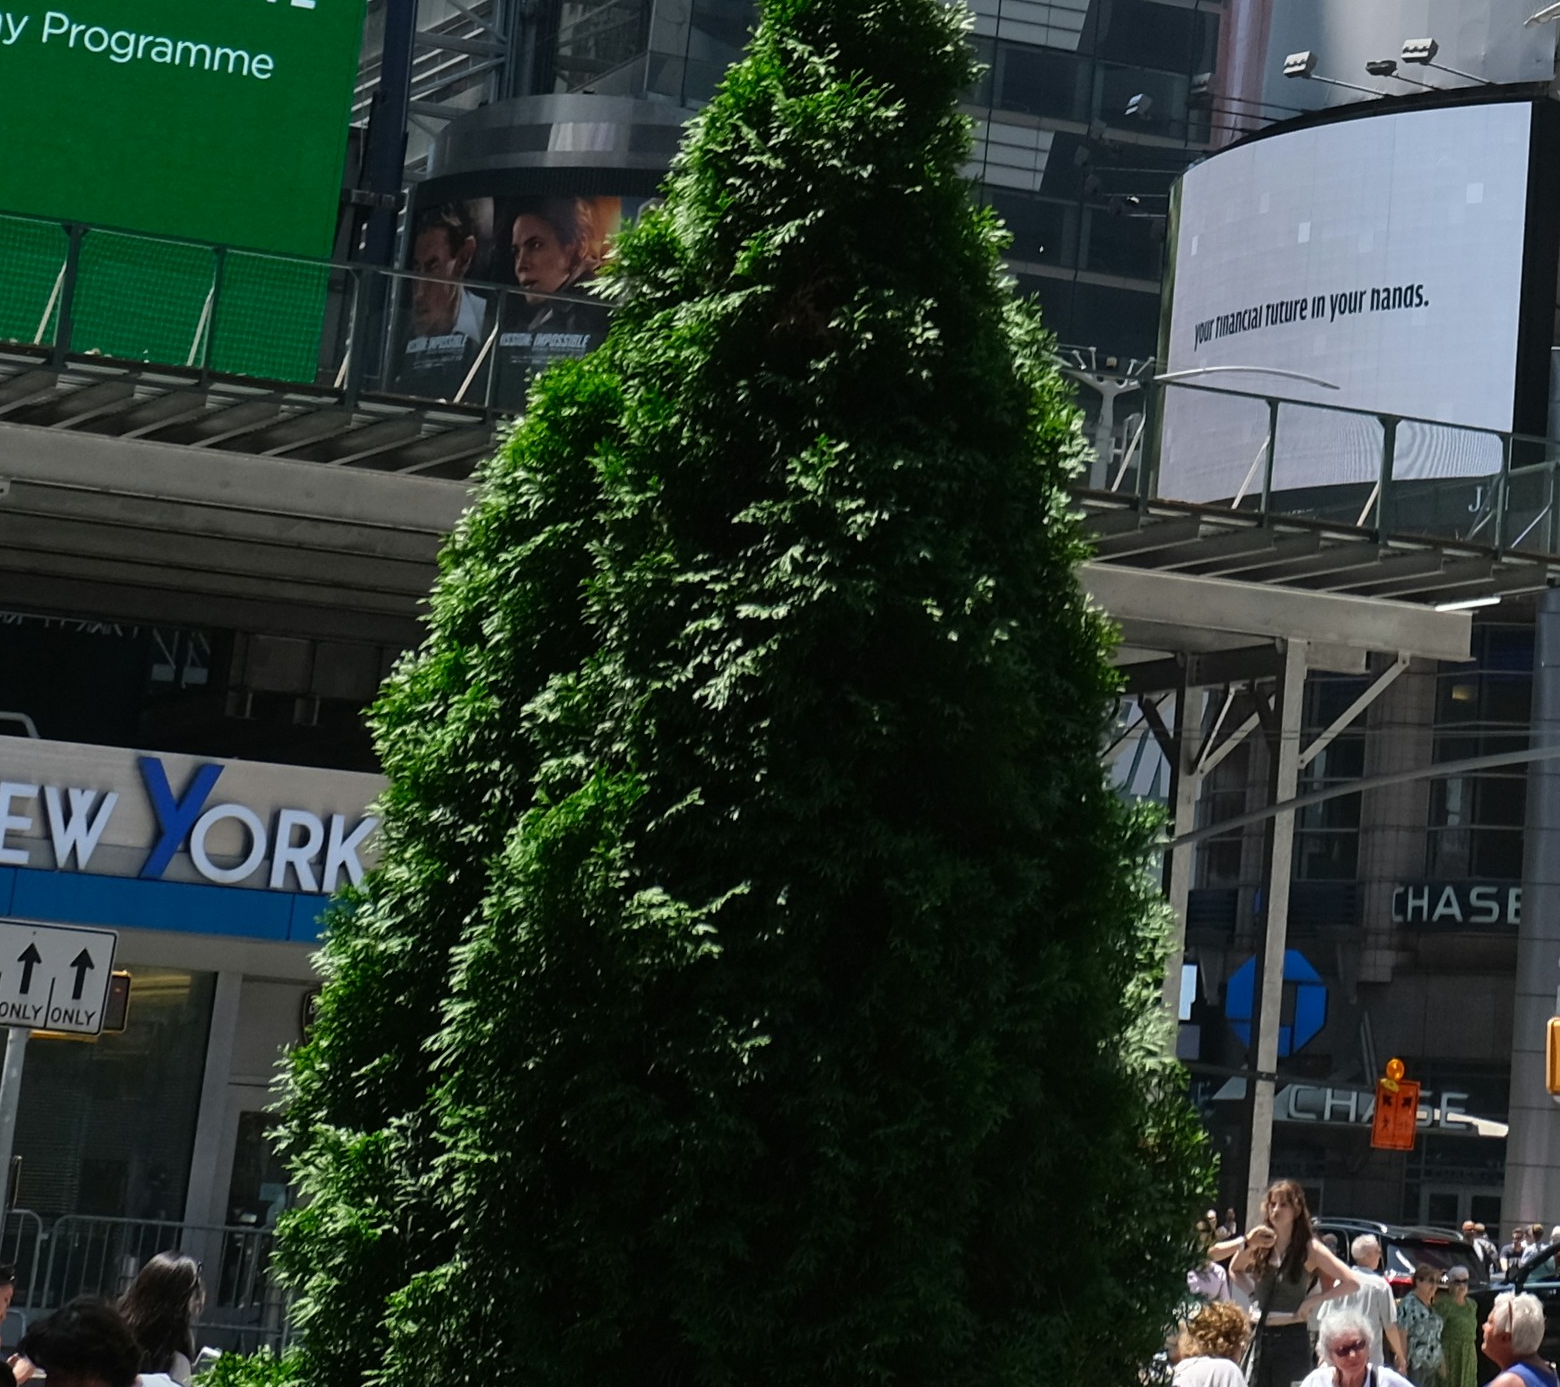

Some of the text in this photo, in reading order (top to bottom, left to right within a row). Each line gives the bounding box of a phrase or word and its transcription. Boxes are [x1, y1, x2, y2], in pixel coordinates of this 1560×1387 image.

[42, 11, 274, 79] Programme
[1193, 317, 1216, 352] your
[1311, 294, 1326, 319] in
[1330, 289, 1367, 323] your
[138, 755, 382, 894] YORK
[50, 1005, 97, 1027] ONLY
